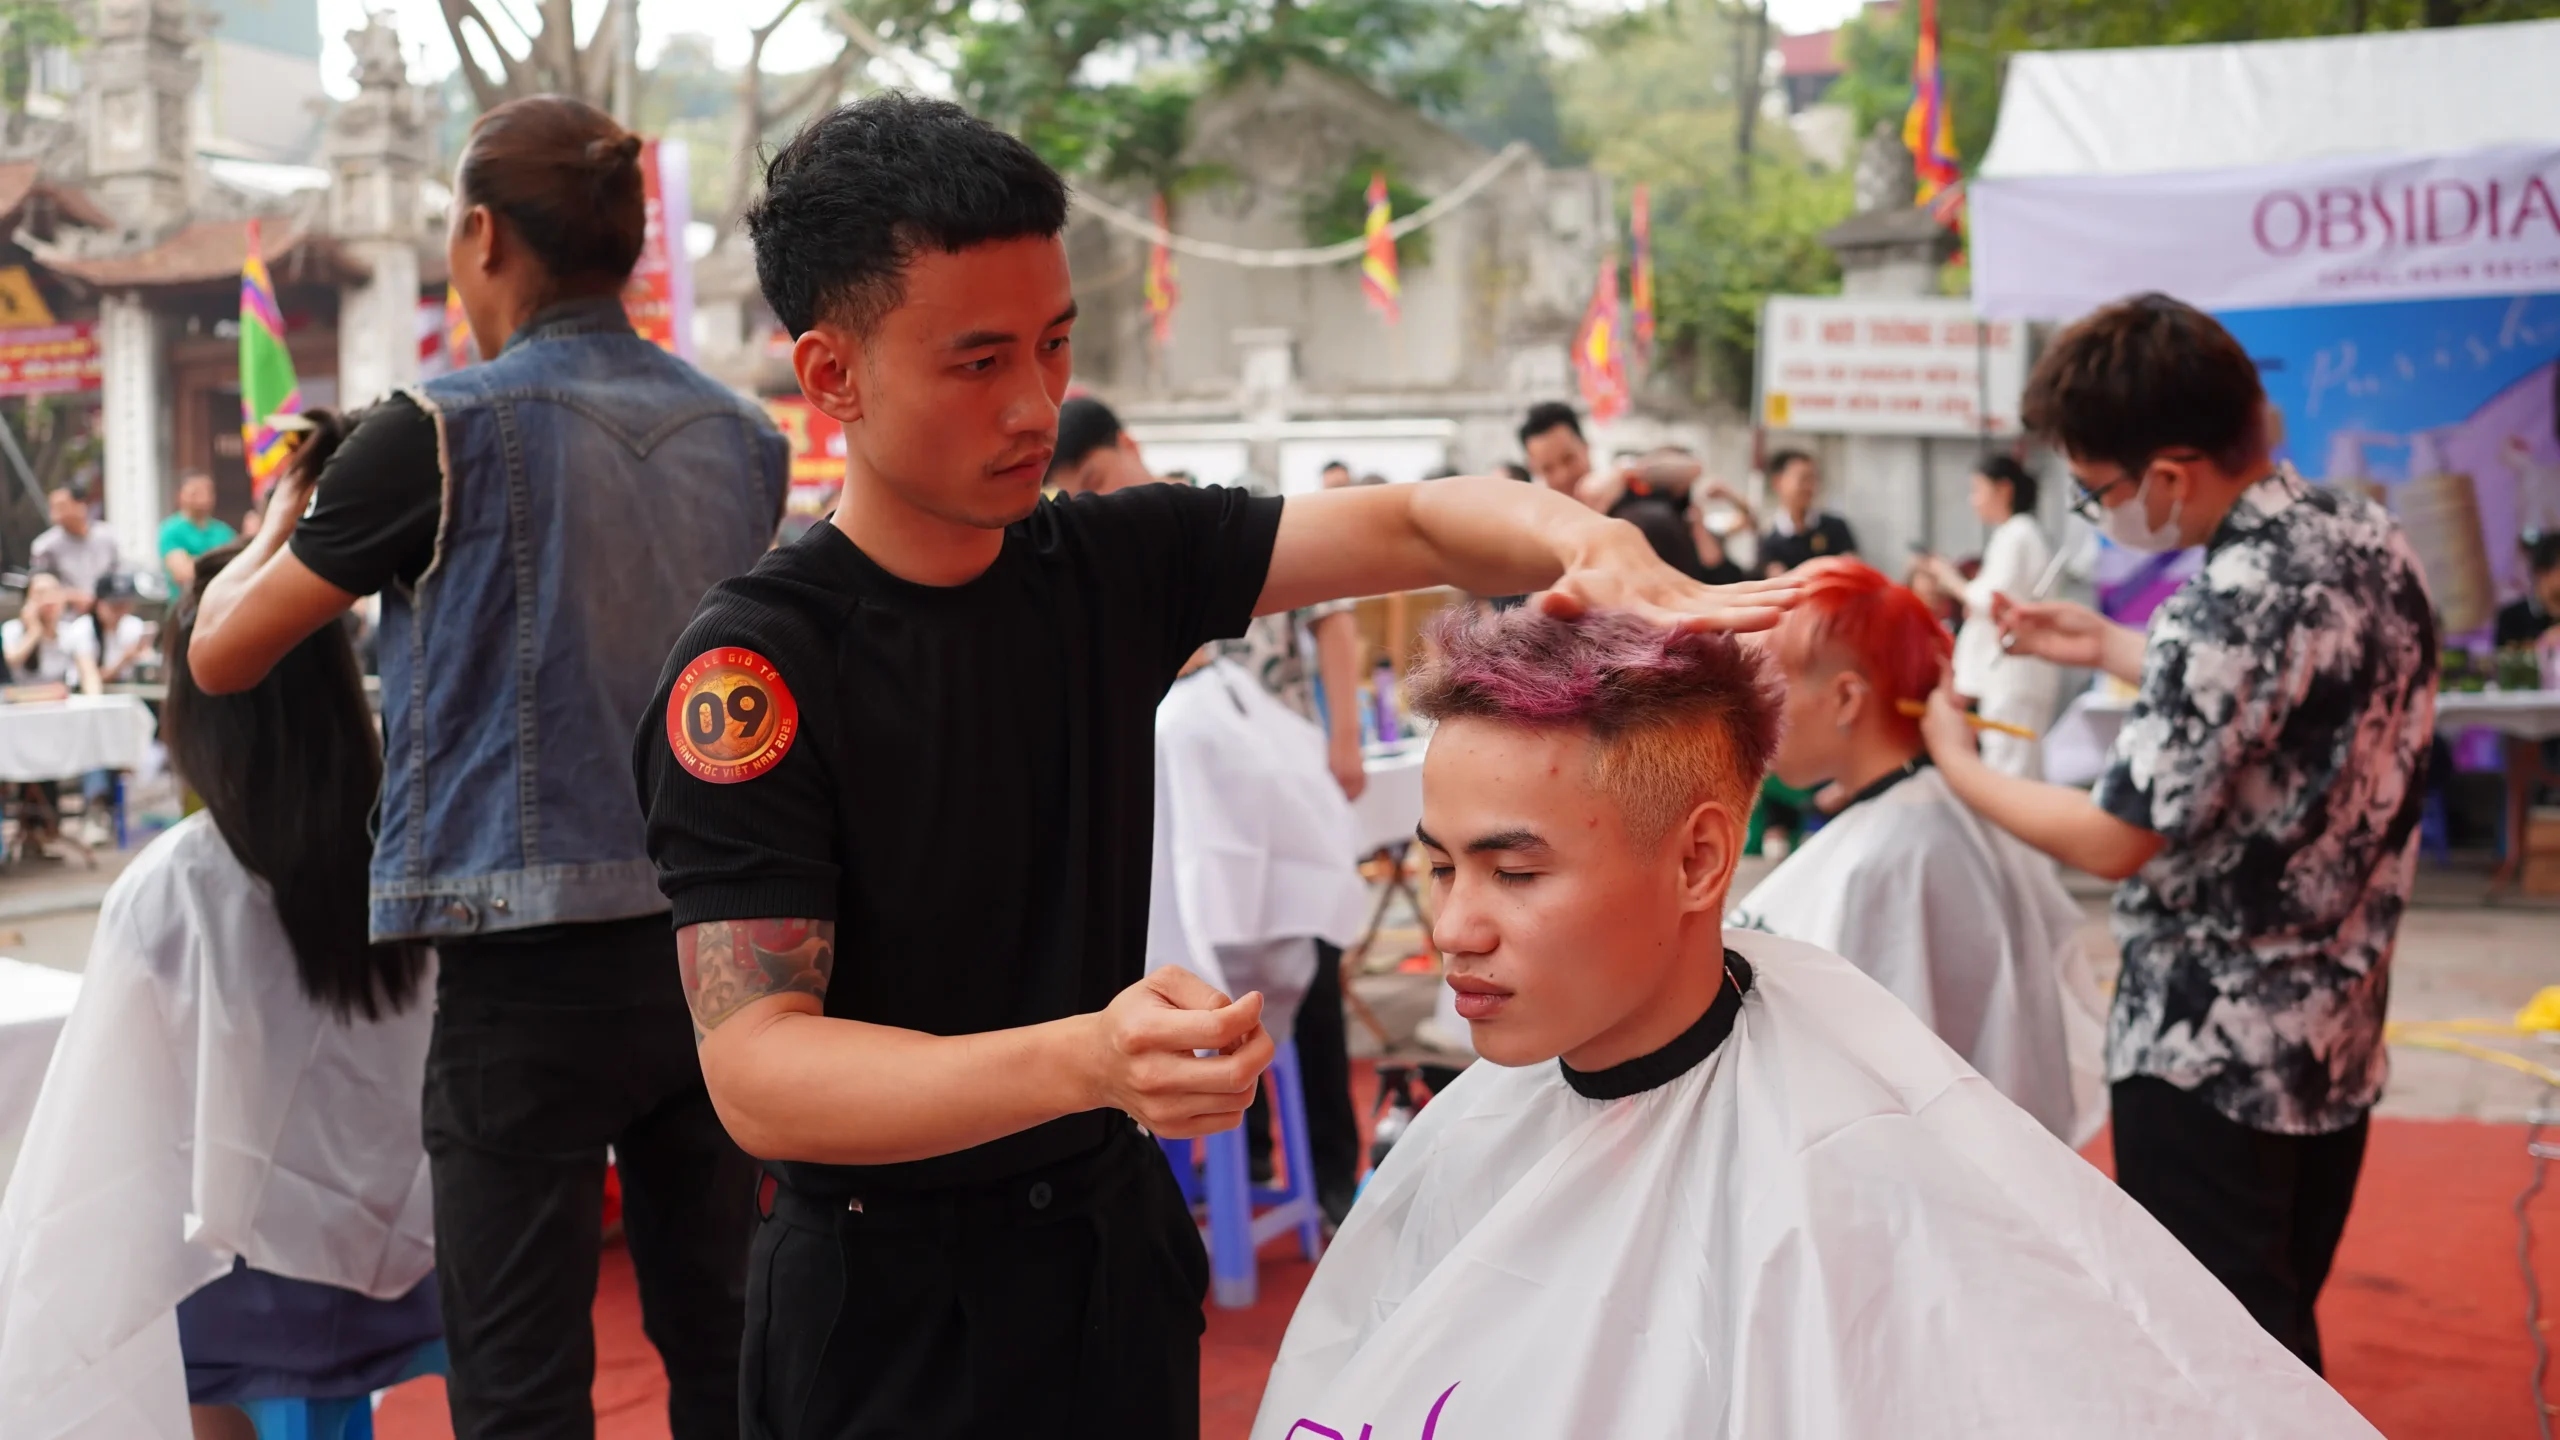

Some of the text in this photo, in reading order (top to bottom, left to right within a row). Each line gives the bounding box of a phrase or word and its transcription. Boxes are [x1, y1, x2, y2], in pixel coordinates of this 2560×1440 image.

[687, 685, 769, 744] 09
[698, 763, 718, 777] TÓC
[723, 765, 748, 778] VIỆT
[752, 748, 777, 770] NAM
[774, 717, 792, 749] 2025
